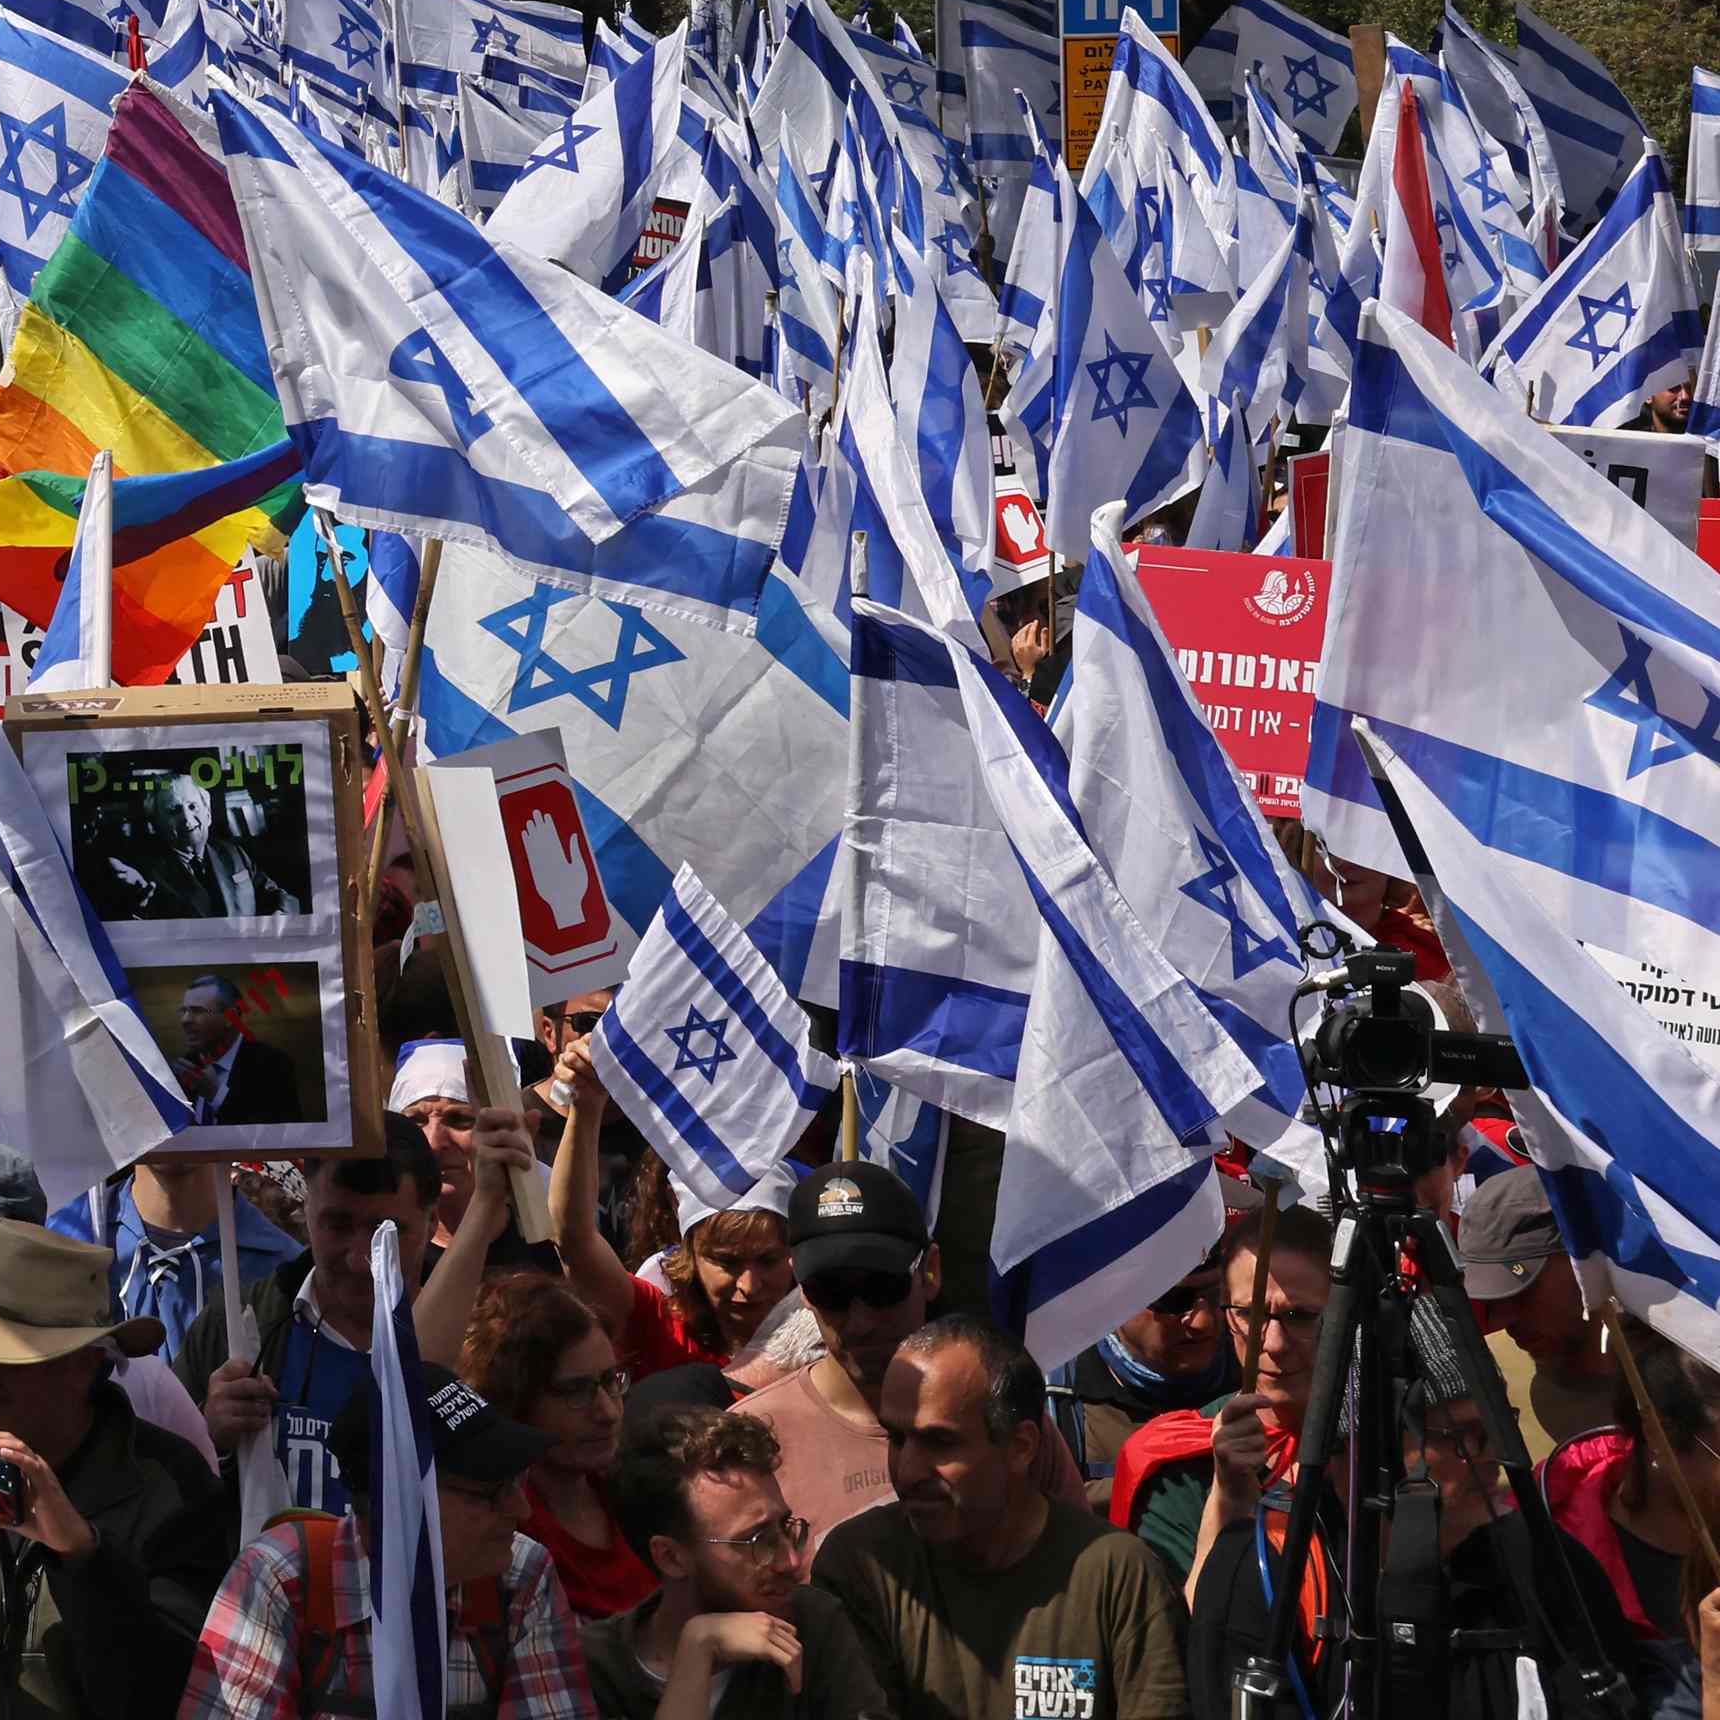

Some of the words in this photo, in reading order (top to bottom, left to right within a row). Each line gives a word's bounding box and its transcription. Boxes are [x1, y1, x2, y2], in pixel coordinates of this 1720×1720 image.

[1170, 647, 1320, 694] האלטרנט
[1250, 708, 1283, 737] אין
[190, 743, 304, 789] לוינס
[1617, 979, 1696, 1006] דמוקר
[426, 1381, 460, 1408] התנועה
[445, 1402, 479, 1431] השלטון
[1015, 1663, 1076, 1693] אחים
[1015, 1688, 1095, 1720] לנשק
